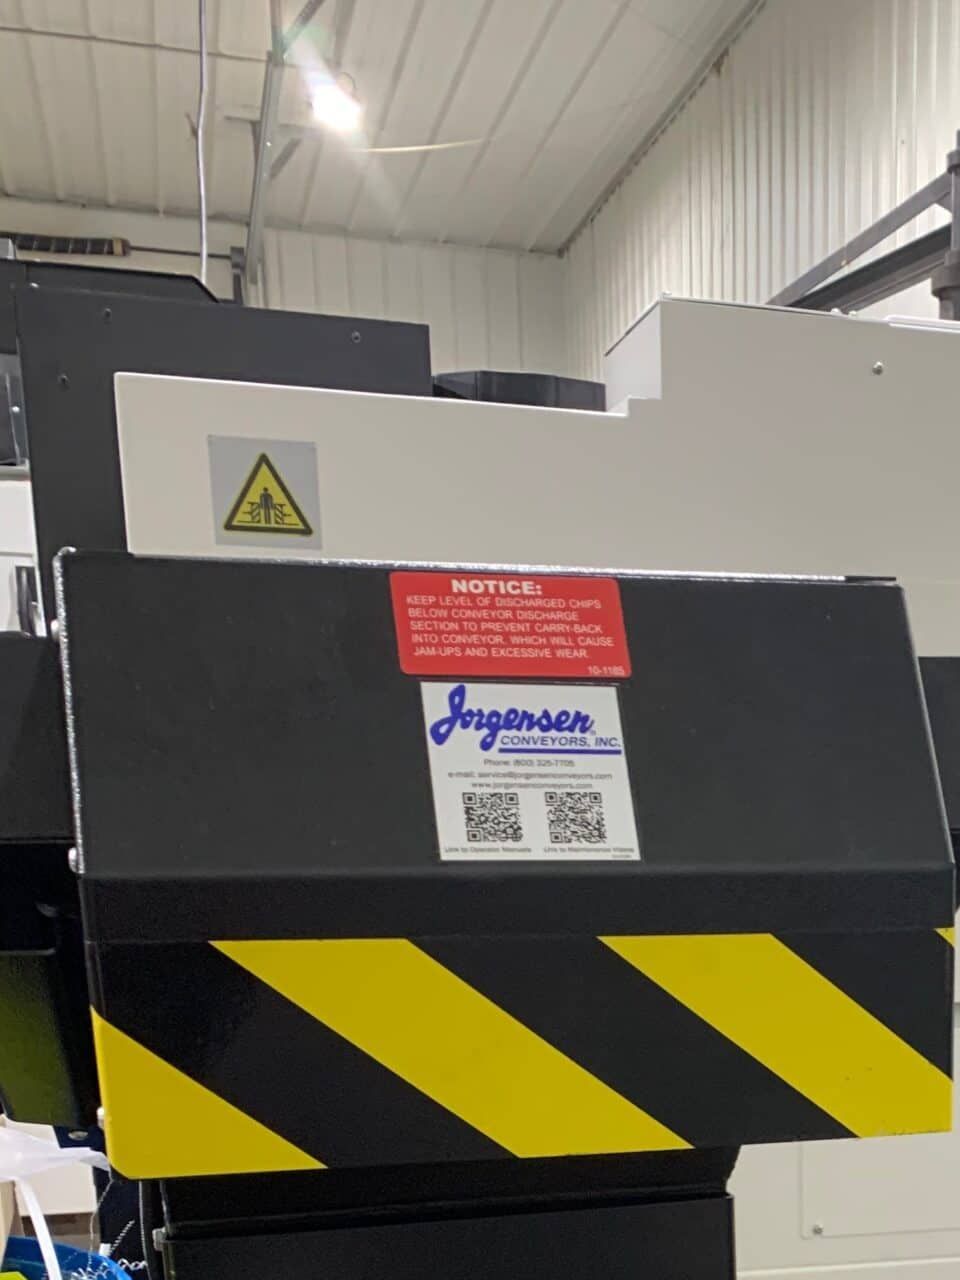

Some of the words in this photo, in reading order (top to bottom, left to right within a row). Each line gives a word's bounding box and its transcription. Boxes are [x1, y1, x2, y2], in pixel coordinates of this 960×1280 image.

[451, 579, 542, 595] NOTICE:
[406, 595, 436, 606] KEEP
[440, 596, 472, 606] LEVEL
[476, 597, 491, 607] OF
[495, 597, 565, 608] DISCHARGED
[569, 599, 601, 609] CHIPS
[408, 607, 448, 618] BELOW
[451, 609, 512, 619] CONVEYOR
[516, 610, 579, 621] DISCHARGE
[410, 620, 459, 631] SECTION
[462, 622, 477, 631] TO
[481, 622, 530, 632] PREVENT
[534, 622, 603, 634] CARRY-BACK
[412, 633, 438, 643] INTO
[510, 635, 547, 645] WHICH
[549, 636, 575, 646] WILL
[577, 637, 615, 647] CAUSE
[414, 646, 462, 657] JAM-UPS
[464, 648, 488, 657] AND
[491, 648, 552, 658] EXCESSIVE
[430, 684, 594, 751] Jorgensen
[595, 736, 621, 747] INC.
